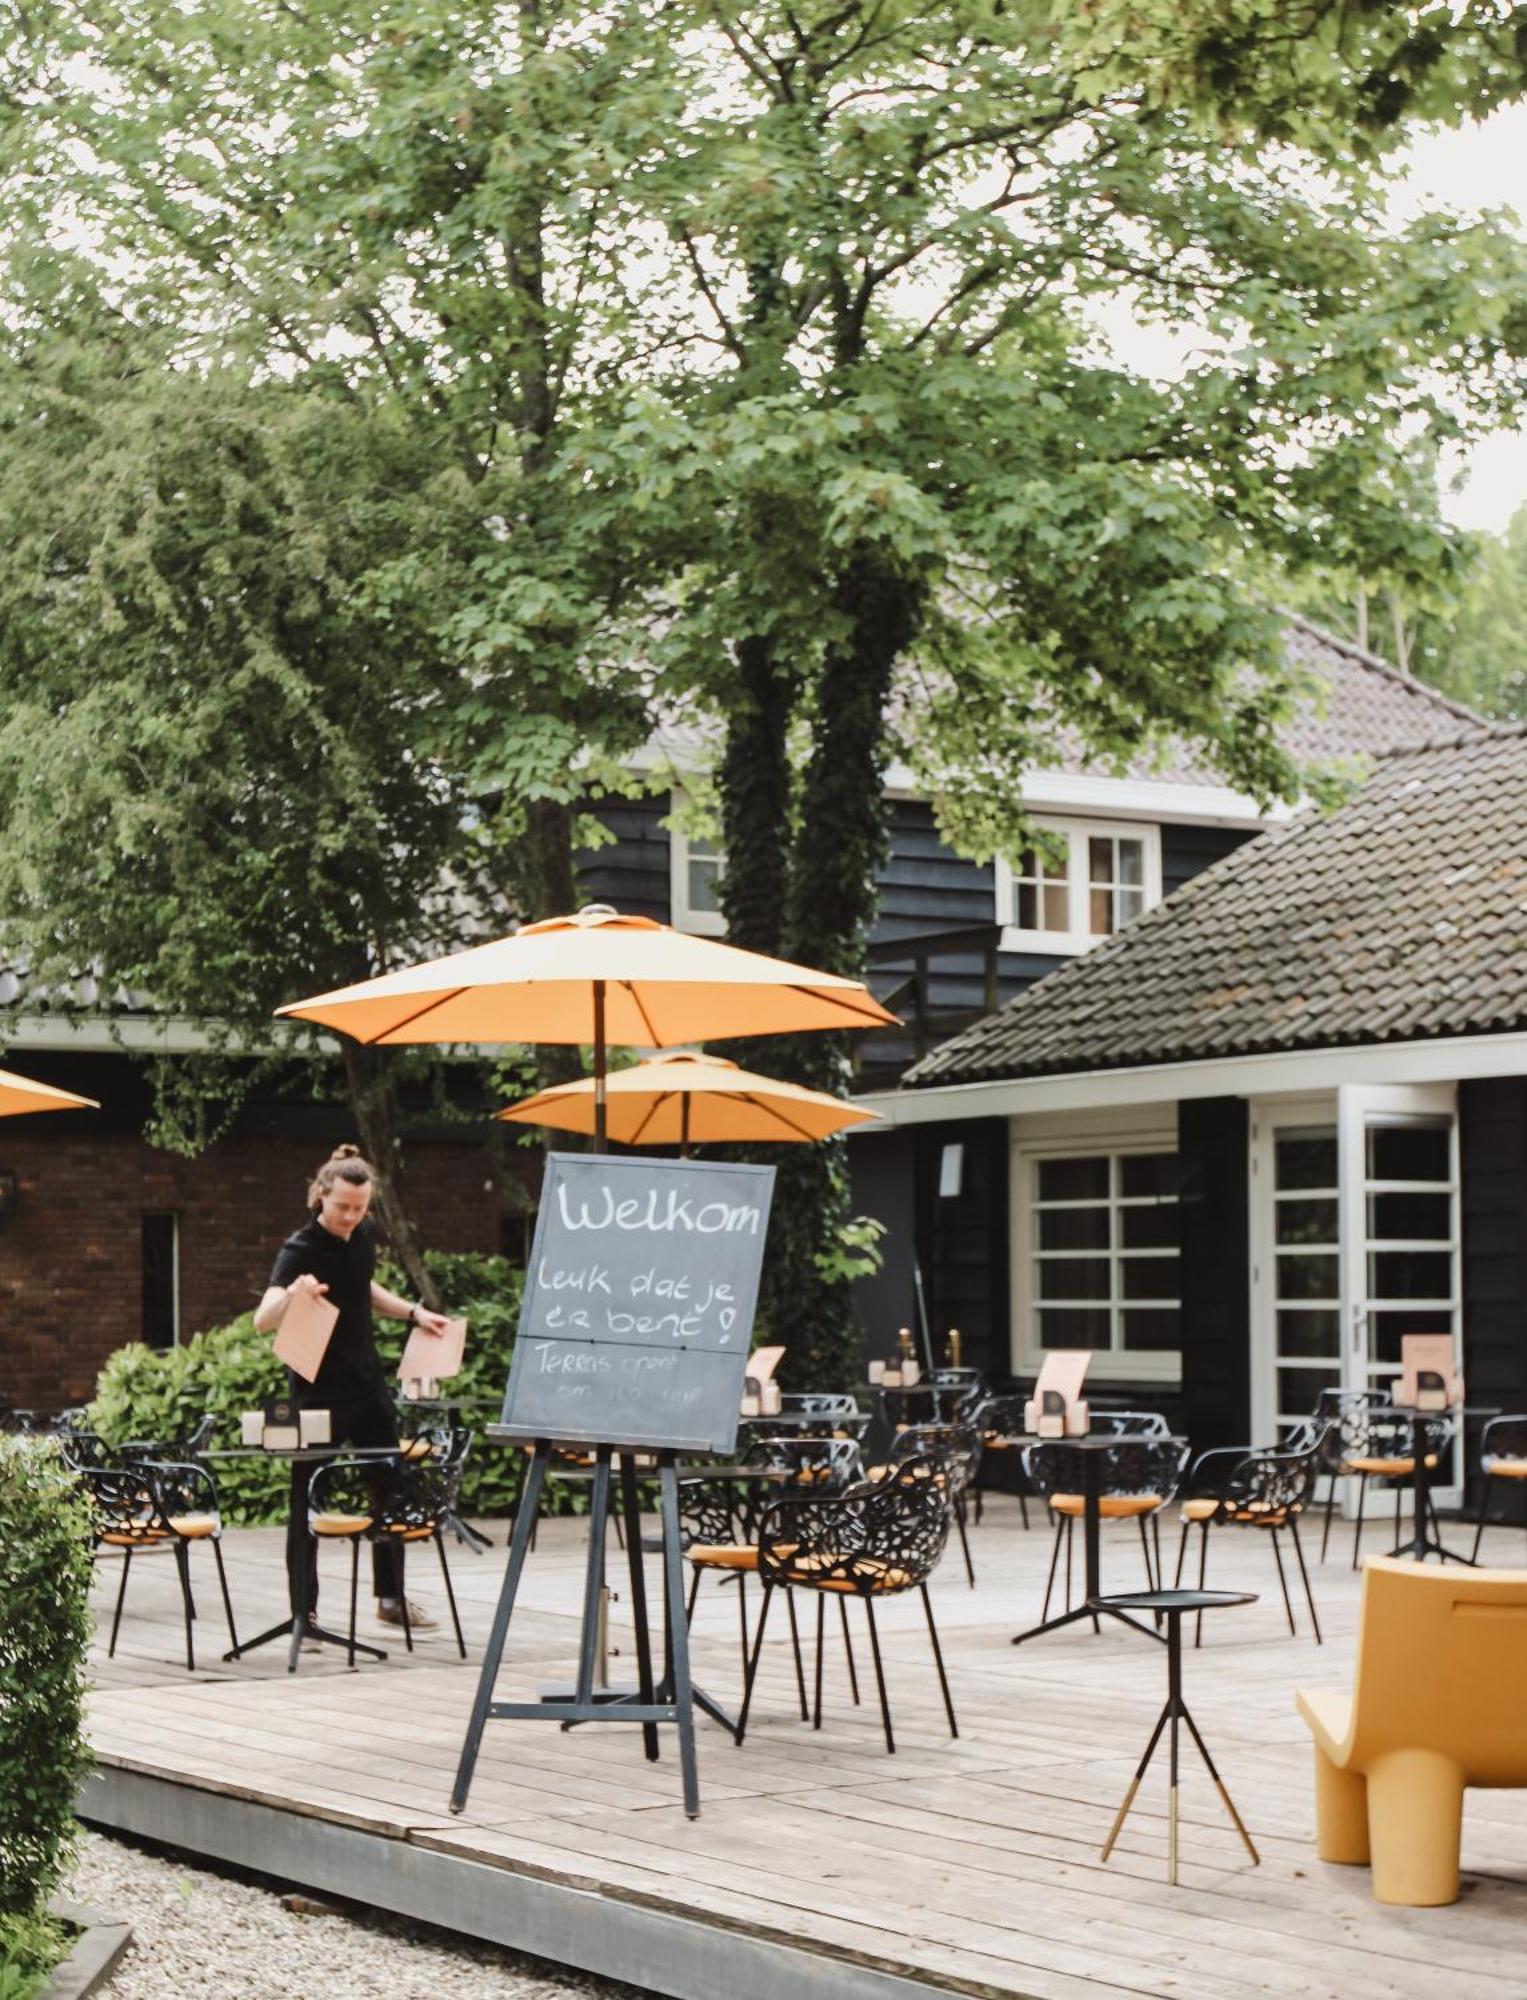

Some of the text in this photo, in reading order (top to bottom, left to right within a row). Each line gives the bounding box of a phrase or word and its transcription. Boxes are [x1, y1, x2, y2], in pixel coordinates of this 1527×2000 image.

[557, 1183, 760, 1235] Welkom
[631, 1268, 692, 1299] dat
[695, 1282, 735, 1313] je
